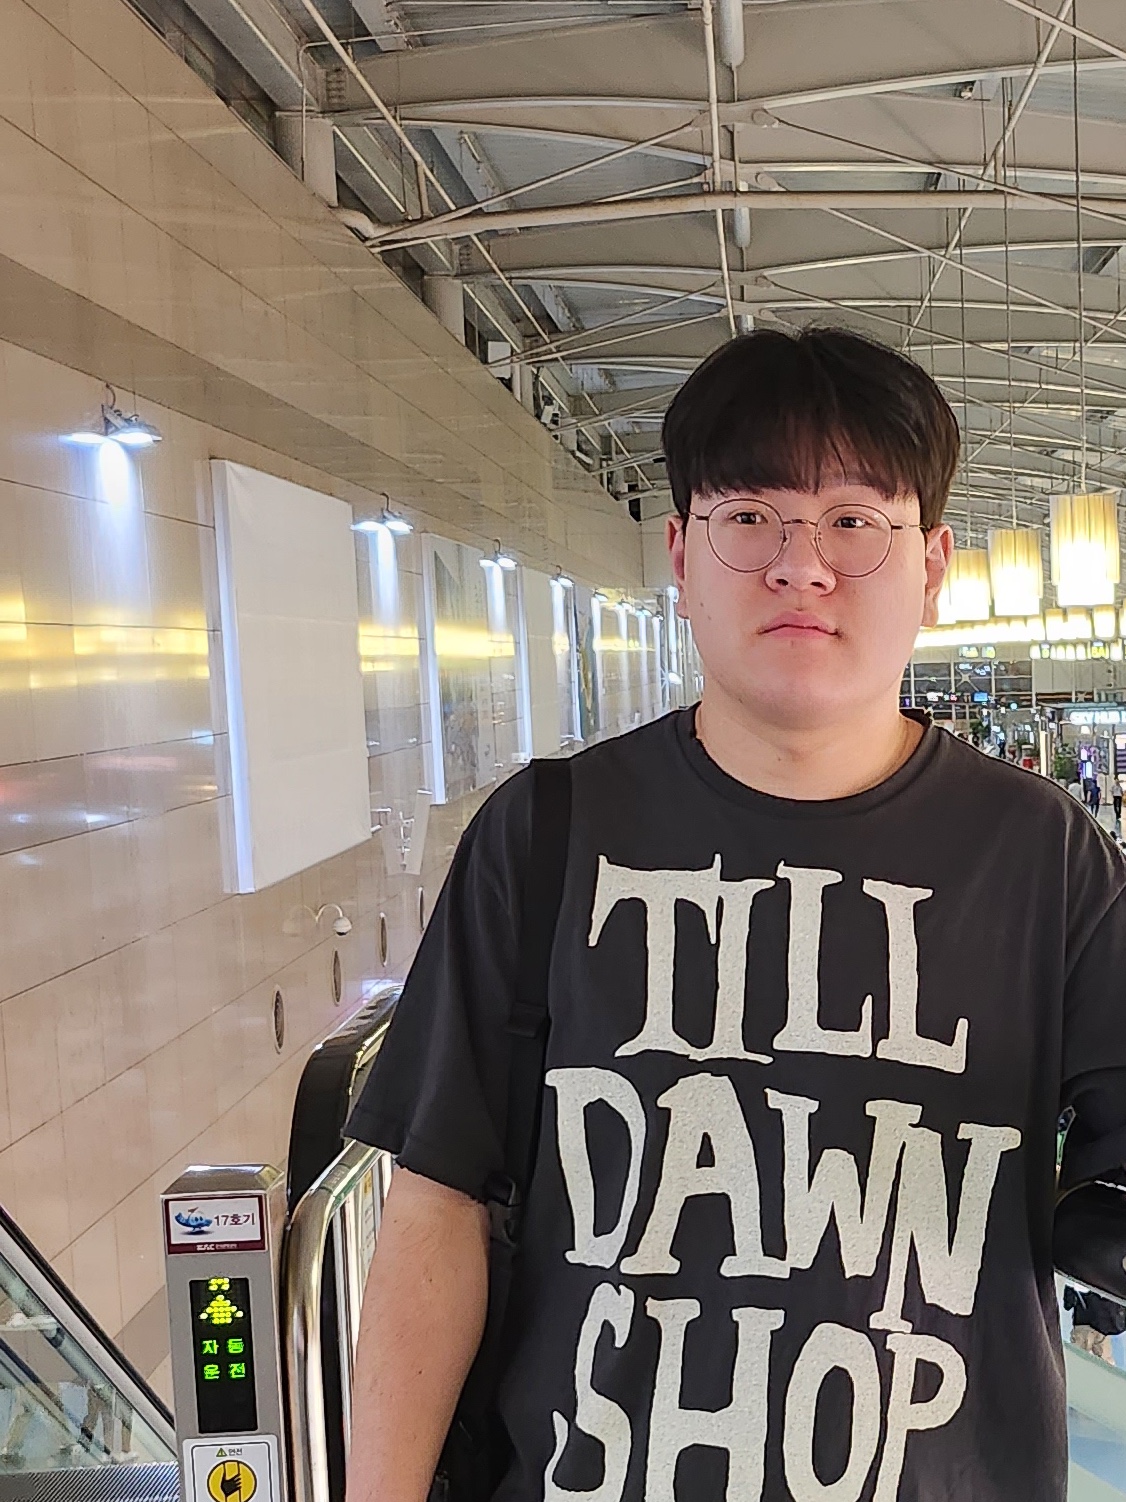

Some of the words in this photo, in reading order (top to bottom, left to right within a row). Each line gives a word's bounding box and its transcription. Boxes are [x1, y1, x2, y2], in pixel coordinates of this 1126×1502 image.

[587, 853, 969, 1073] TILL
[544, 1067, 1022, 1332] DAWN
[214, 1212, 256, 1226] 17호기
[202, 1338, 245, 1354] 자동
[203, 1363, 246, 1379] 운전
